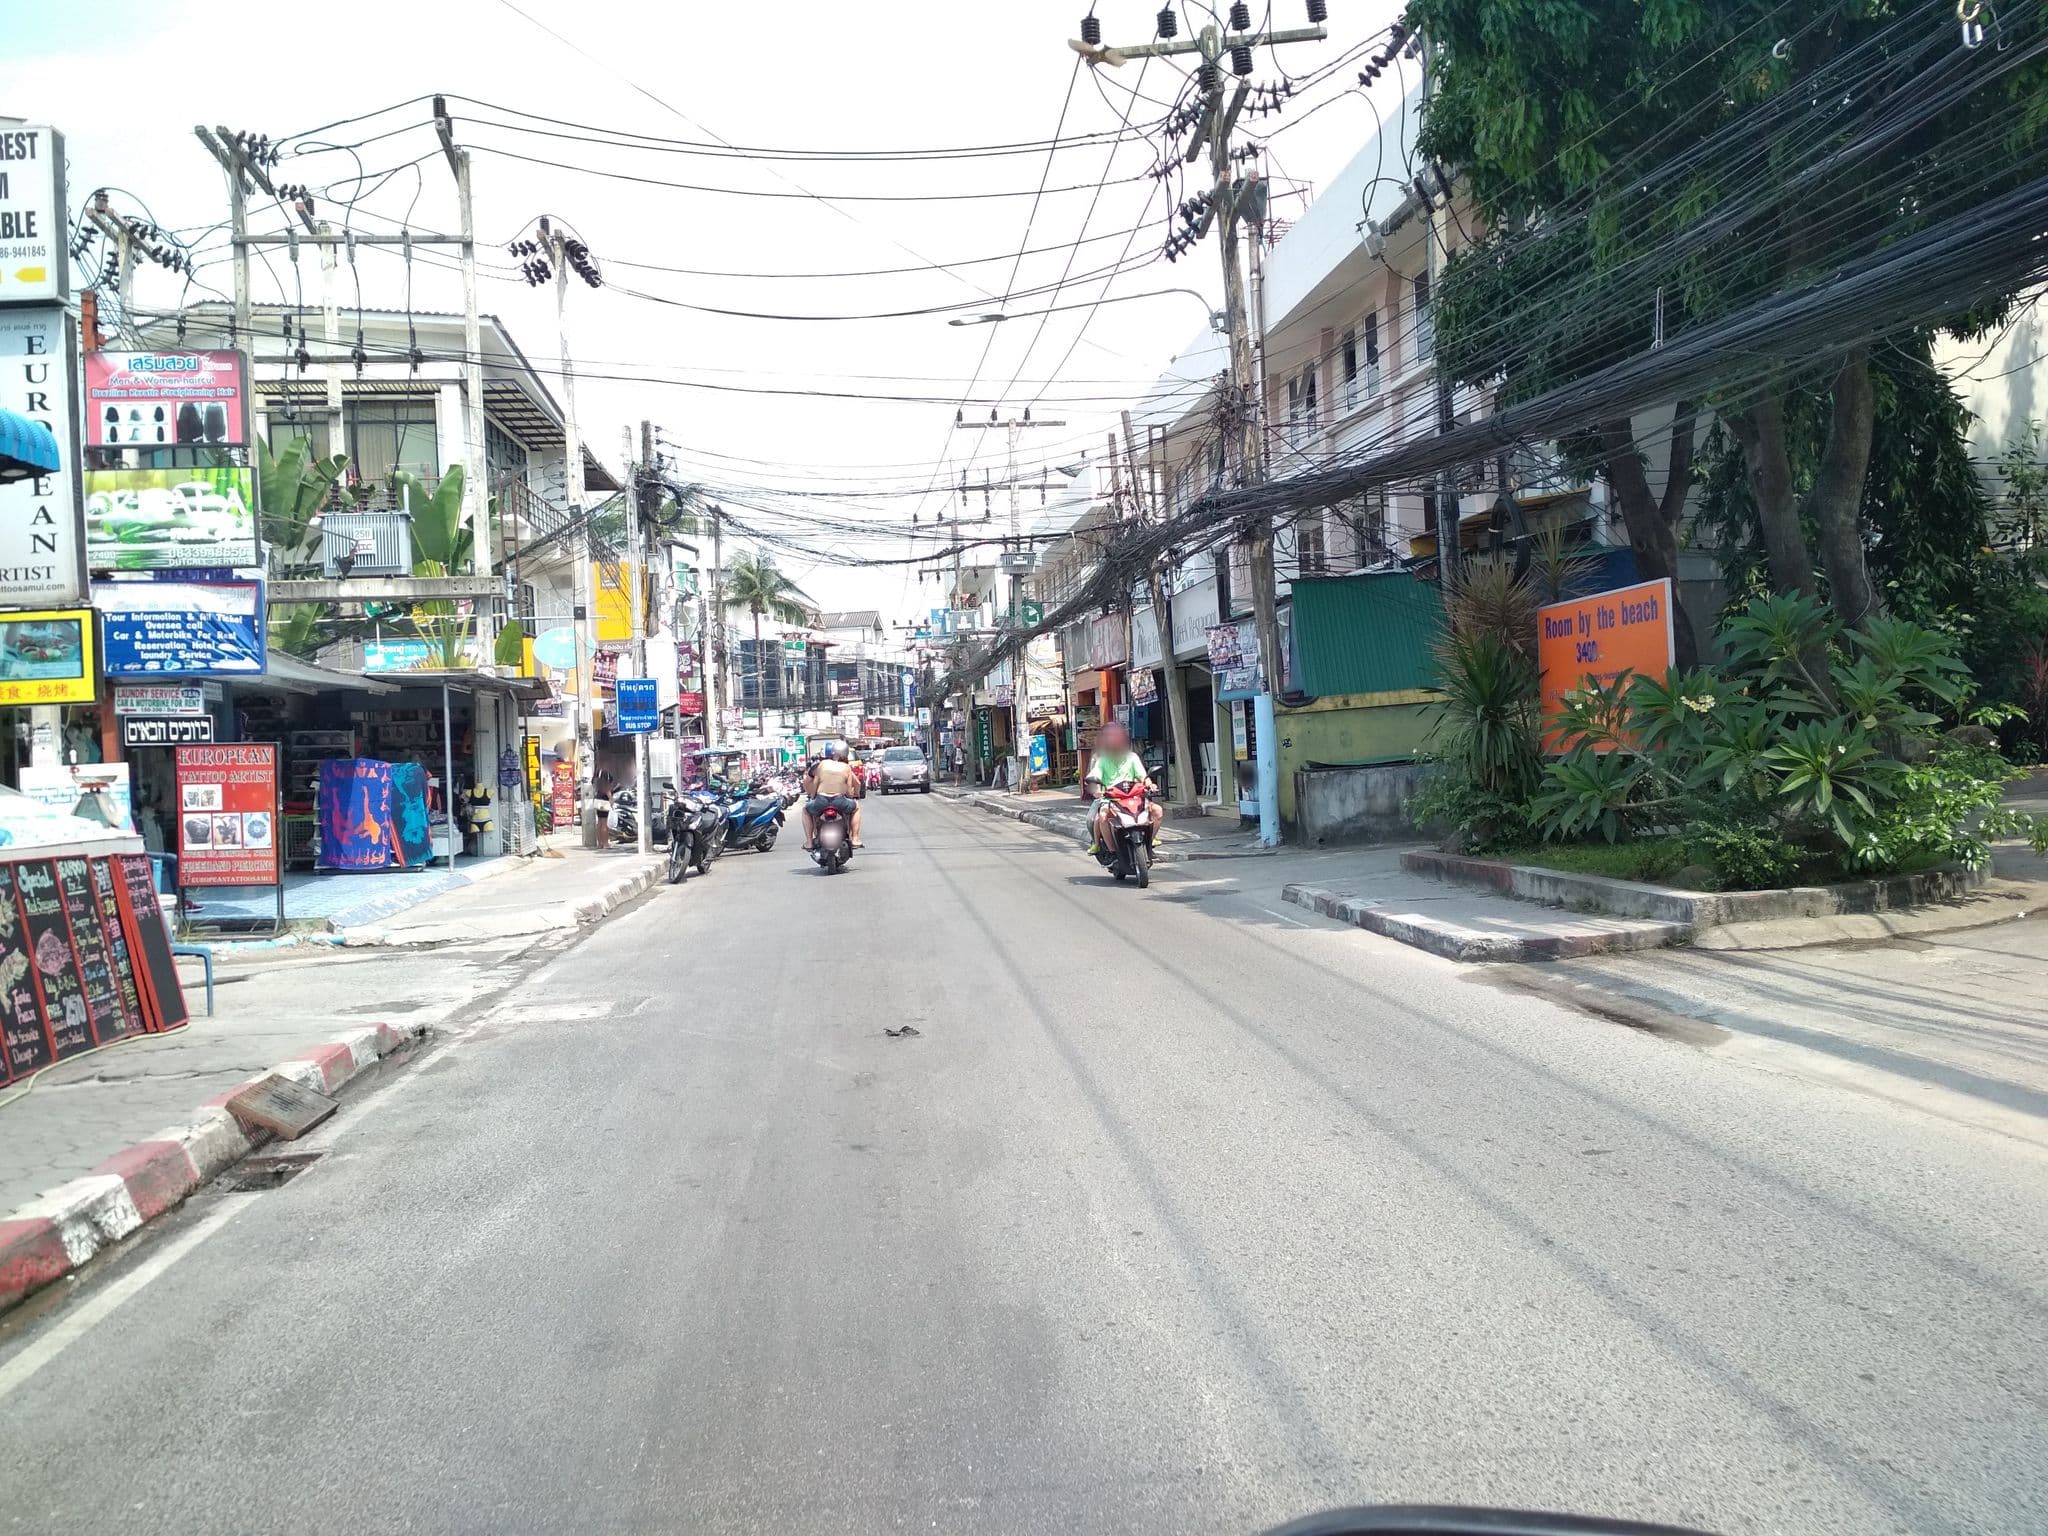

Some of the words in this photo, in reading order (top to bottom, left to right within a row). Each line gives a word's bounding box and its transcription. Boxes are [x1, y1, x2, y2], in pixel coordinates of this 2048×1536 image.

[110, 376, 130, 386] Men
[131, 377, 140, 385] &
[144, 376, 182, 386] Women
[106, 613, 126, 622] Tour
[131, 612, 181, 622] Information
[186, 613, 195, 621] &
[1545, 616, 1574, 640] Room
[1578, 610, 1592, 638] by
[1597, 605, 1616, 631] the
[1621, 594, 1659, 626] beach
[145, 621, 182, 630] Oversea
[113, 631, 129, 641] Car
[134, 631, 143, 640] &
[148, 630, 193, 640] Motorbike
[133, 641, 187, 651] Reservation
[178, 651, 212, 660] Service
[117, 687, 149, 698] LAUNDRY
[151, 687, 180, 698] SERVICE
[117, 699, 129, 707] CAR
[184, 698, 200, 707] RENT
[178, 748, 273, 766] EUROPEAN
[178, 770, 227, 783] TATTOO
[228, 770, 273, 784] ARTIST
